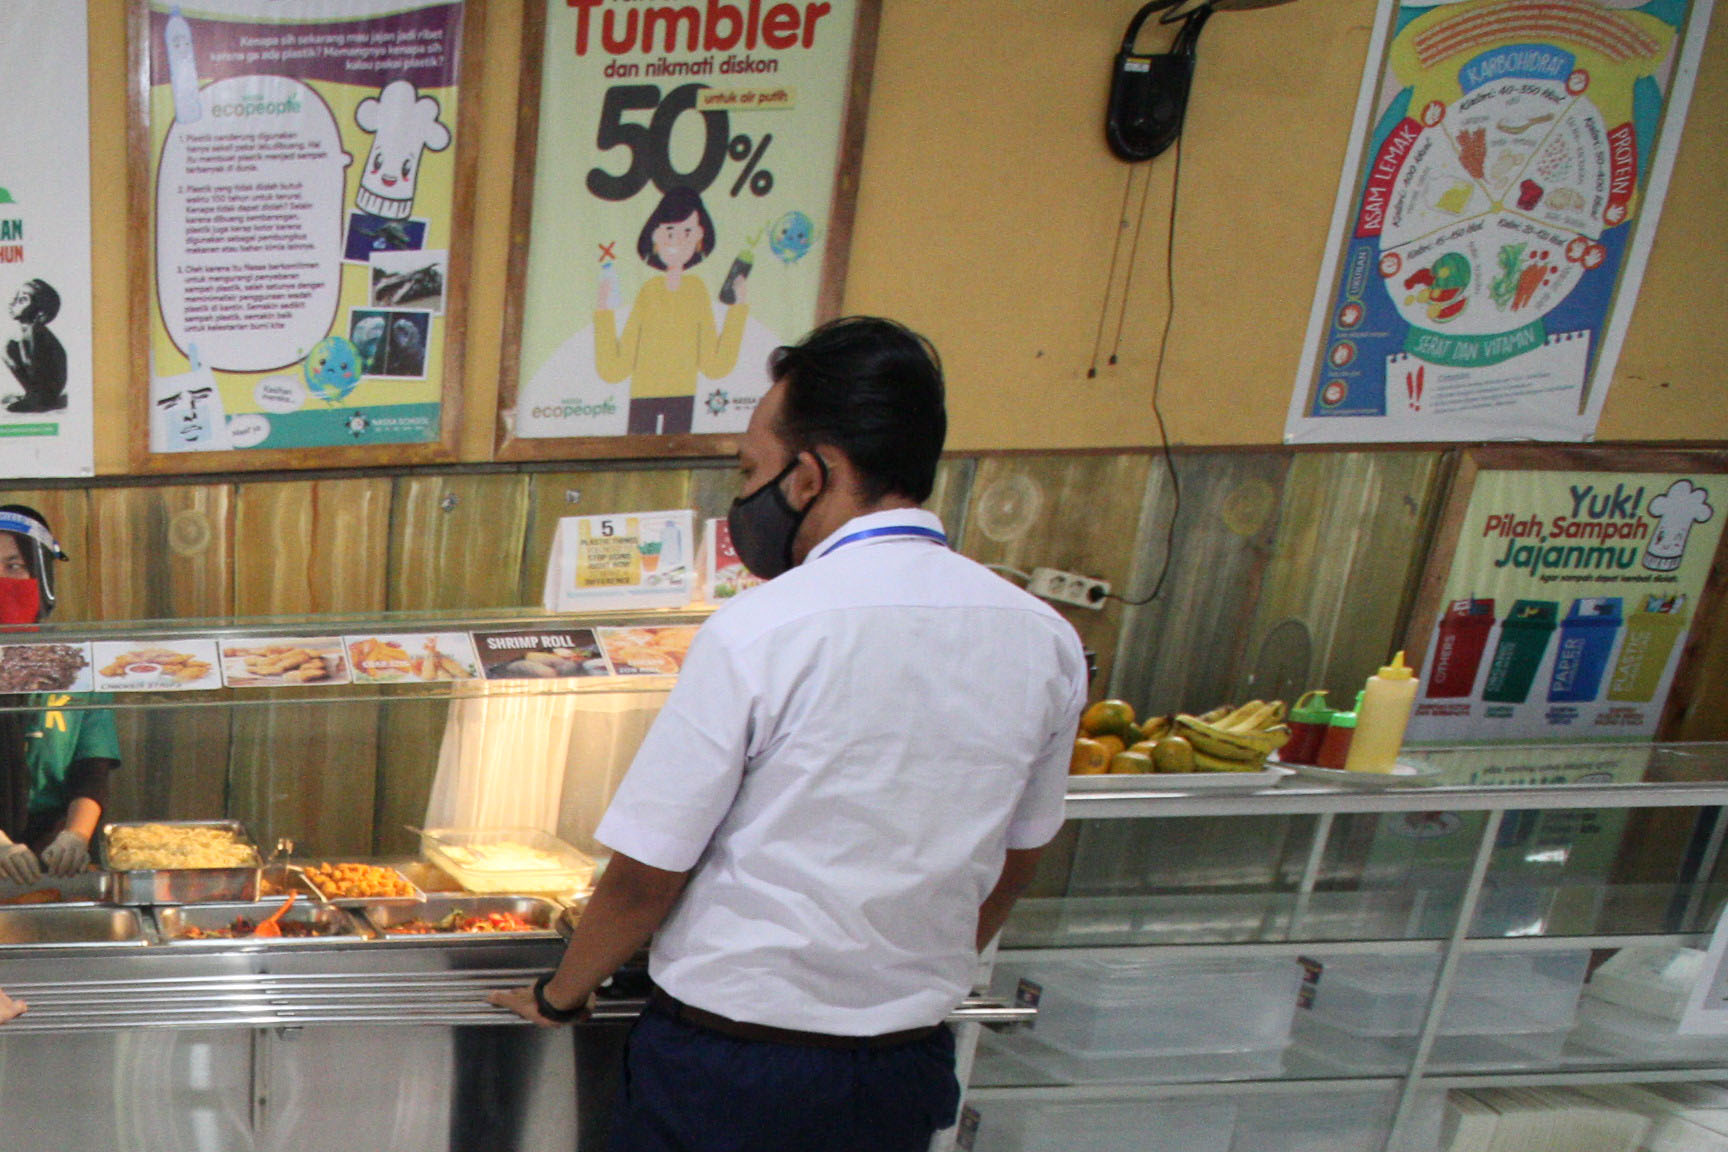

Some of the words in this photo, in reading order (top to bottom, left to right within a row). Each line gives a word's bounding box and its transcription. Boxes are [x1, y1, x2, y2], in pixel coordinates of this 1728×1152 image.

[566, 0, 831, 56] Tumbler
[604, 60, 639, 78] dan
[645, 54, 714, 77] nikmati
[719, 55, 778, 75] diskon
[1467, 50, 1563, 85] KARBOHIDRAT
[704, 91, 736, 106] untuk
[759, 89, 788, 106] putih
[585, 83, 774, 201] 50%
[1363, 187, 1388, 230] ASAM
[1380, 125, 1418, 182] LEMAK
[1611, 127, 1630, 195] PROTEIN
[1419, 335, 1451, 355] SERAT
[1483, 328, 1535, 358] VITAMIN
[1569, 483, 1645, 520] Yuk!
[601, 520, 614, 537] 5
[1482, 514, 1543, 539] Pilah
[1549, 516, 1649, 546] Sampah
[1494, 536, 1638, 577] Jajanmu
[486, 636, 538, 650] SHRIMP
[541, 634, 576, 648] ROLL
[1551, 638, 1578, 692] PAPER
